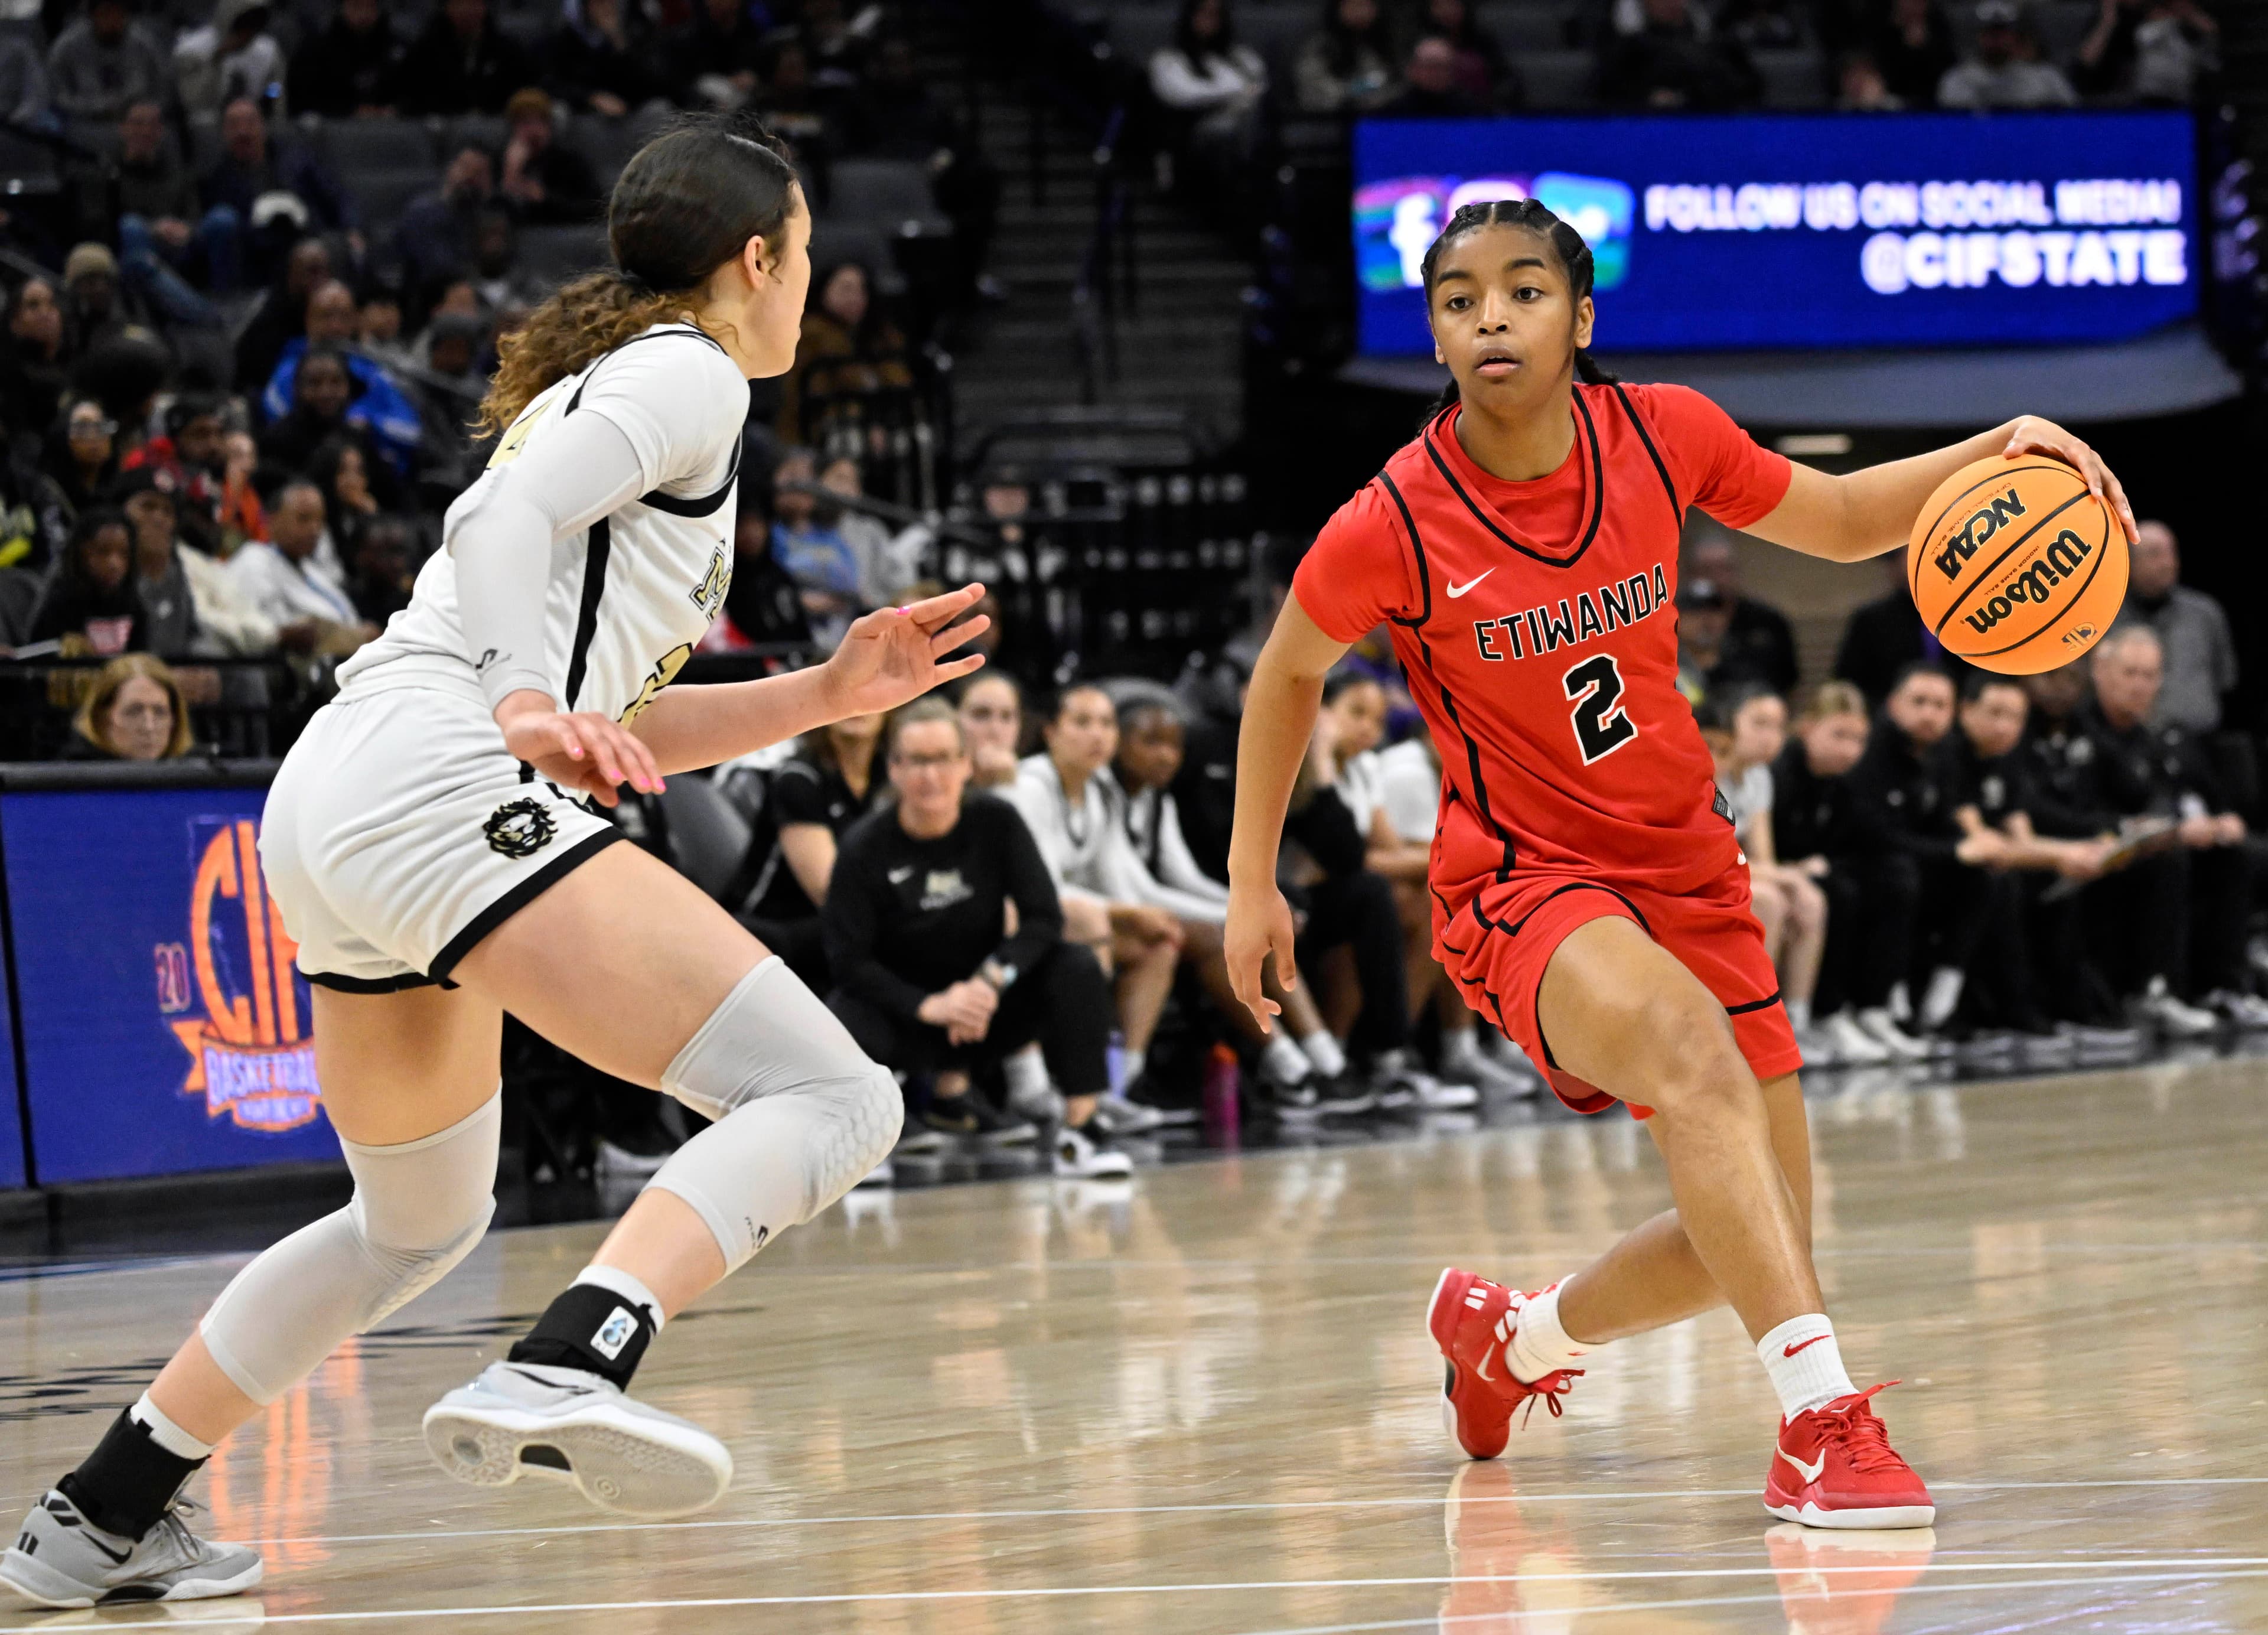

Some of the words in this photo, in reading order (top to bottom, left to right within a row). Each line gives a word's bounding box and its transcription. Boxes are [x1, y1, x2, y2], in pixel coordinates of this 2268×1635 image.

[1645, 184, 1799, 232] FOLLOW
[1804, 183, 1859, 231] US
[1860, 182, 1918, 228] ON
[1922, 181, 2052, 227] SOCIAL
[2055, 179, 2181, 225] MEDIA!
[1862, 230, 2188, 295] @CIFSTATE
[1930, 535, 1947, 556] BALL
[1934, 488, 2026, 581] NCAA
[1947, 510, 1970, 532] GAME
[1964, 529, 2092, 634] Wilson
[2000, 568, 2018, 583] GAME
[2018, 546, 2039, 567] INDOOR
[1474, 562, 1668, 661] ETIWANDA
[1984, 585, 1999, 595] BALL
[2065, 622, 2095, 652] CIF
[1562, 653, 1638, 766] 2
[204, 1046, 321, 1107] BASKETBAL
